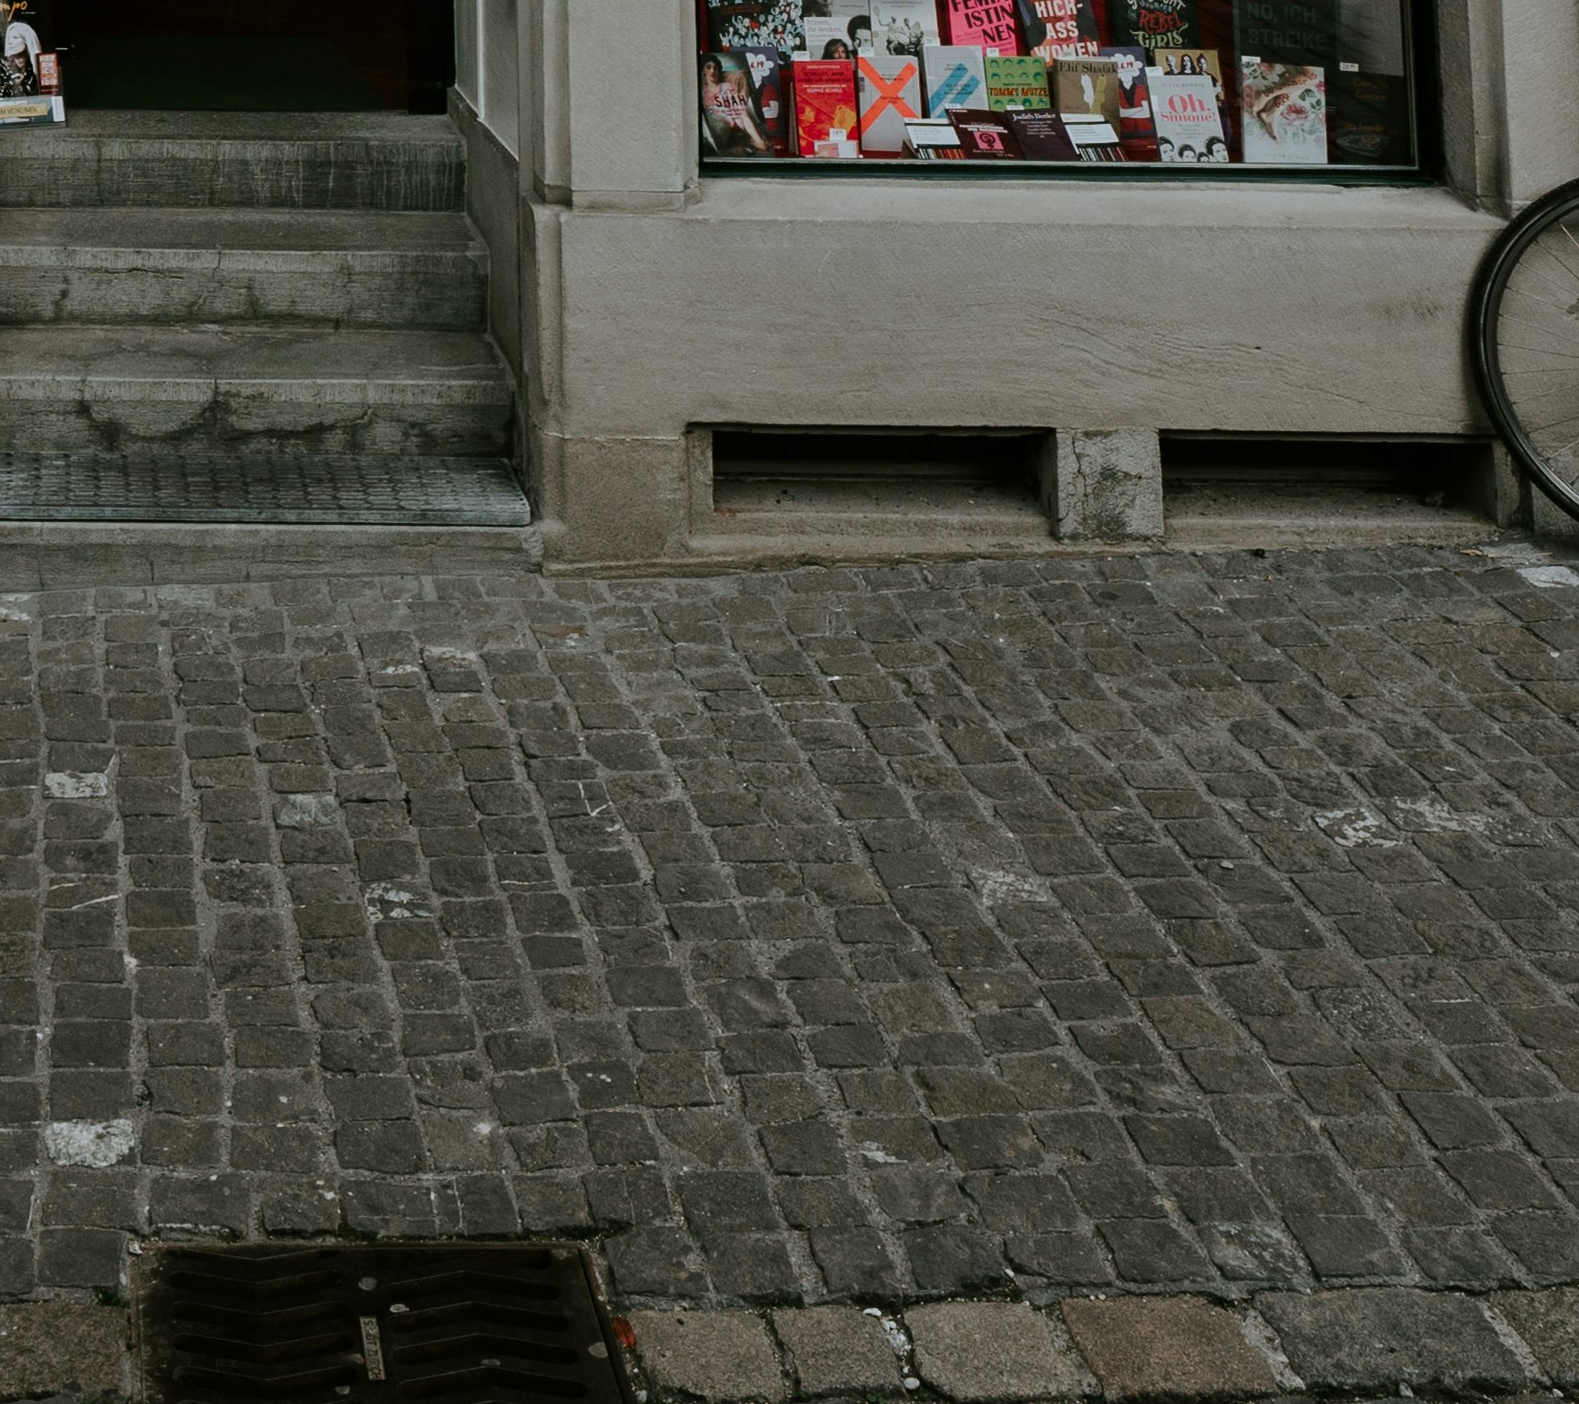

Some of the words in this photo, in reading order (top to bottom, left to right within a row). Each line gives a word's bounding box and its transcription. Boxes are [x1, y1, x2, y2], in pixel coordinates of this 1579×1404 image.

[964, 3, 1015, 29] ISTIN
[1283, 5, 1317, 23] ICH
[1046, 21, 1079, 39] ASS
[1034, 41, 1099, 62] WOMEN
[1059, 62, 1081, 73] Elif
[1081, 62, 1118, 73] Shafak
[714, 94, 747, 108] SHAH
[1168, 93, 1211, 113] Oh,
[1160, 112, 1217, 122] Simone!
